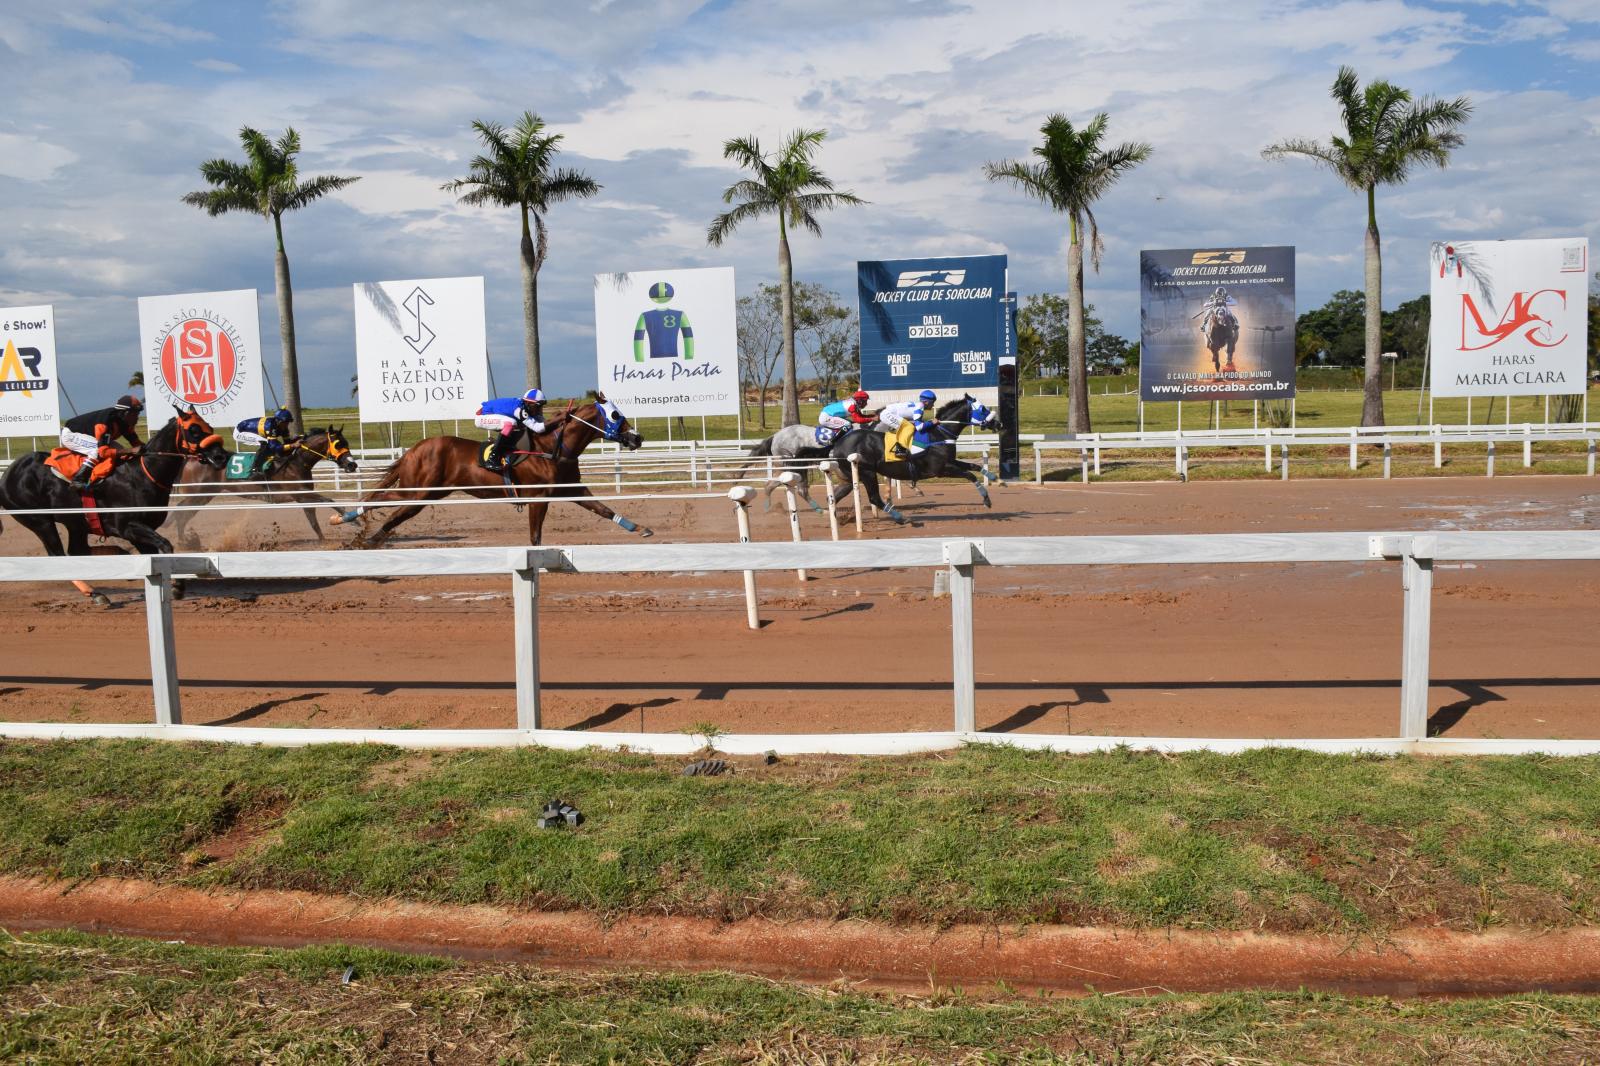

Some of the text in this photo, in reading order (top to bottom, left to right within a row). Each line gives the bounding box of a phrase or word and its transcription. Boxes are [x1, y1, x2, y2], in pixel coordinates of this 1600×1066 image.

[1172, 264, 1267, 276] JOCKEY CLUB DE SOROCABA
[872, 287, 993, 303] JOCKEY CLUB DE SOROCABA
[4, 319, 47, 331] é Show!
[923, 315, 943, 325] DATA
[152, 308, 247, 365] HARAS SÃO MATHEUS
[381, 356, 462, 368] HARAS
[887, 353, 911, 365] PÁREO
[953, 350, 991, 362] DISTÂNCIA
[1492, 354, 1535, 366] HARAS
[613, 361, 722, 383] Haras Prata
[963, 363, 983, 373] 301
[1250, 370, 1272, 378] MUNDO
[382, 369, 464, 384] FAZENDA
[1456, 371, 1566, 386] MARIA CLARA
[201, 406, 217, 416] DE
[218, 371, 247, 409] MILHA
[1152, 380, 1290, 394] www.jcsorocaba.com.br
[382, 387, 416, 403] SÃO
[231, 455, 244, 475] 5
